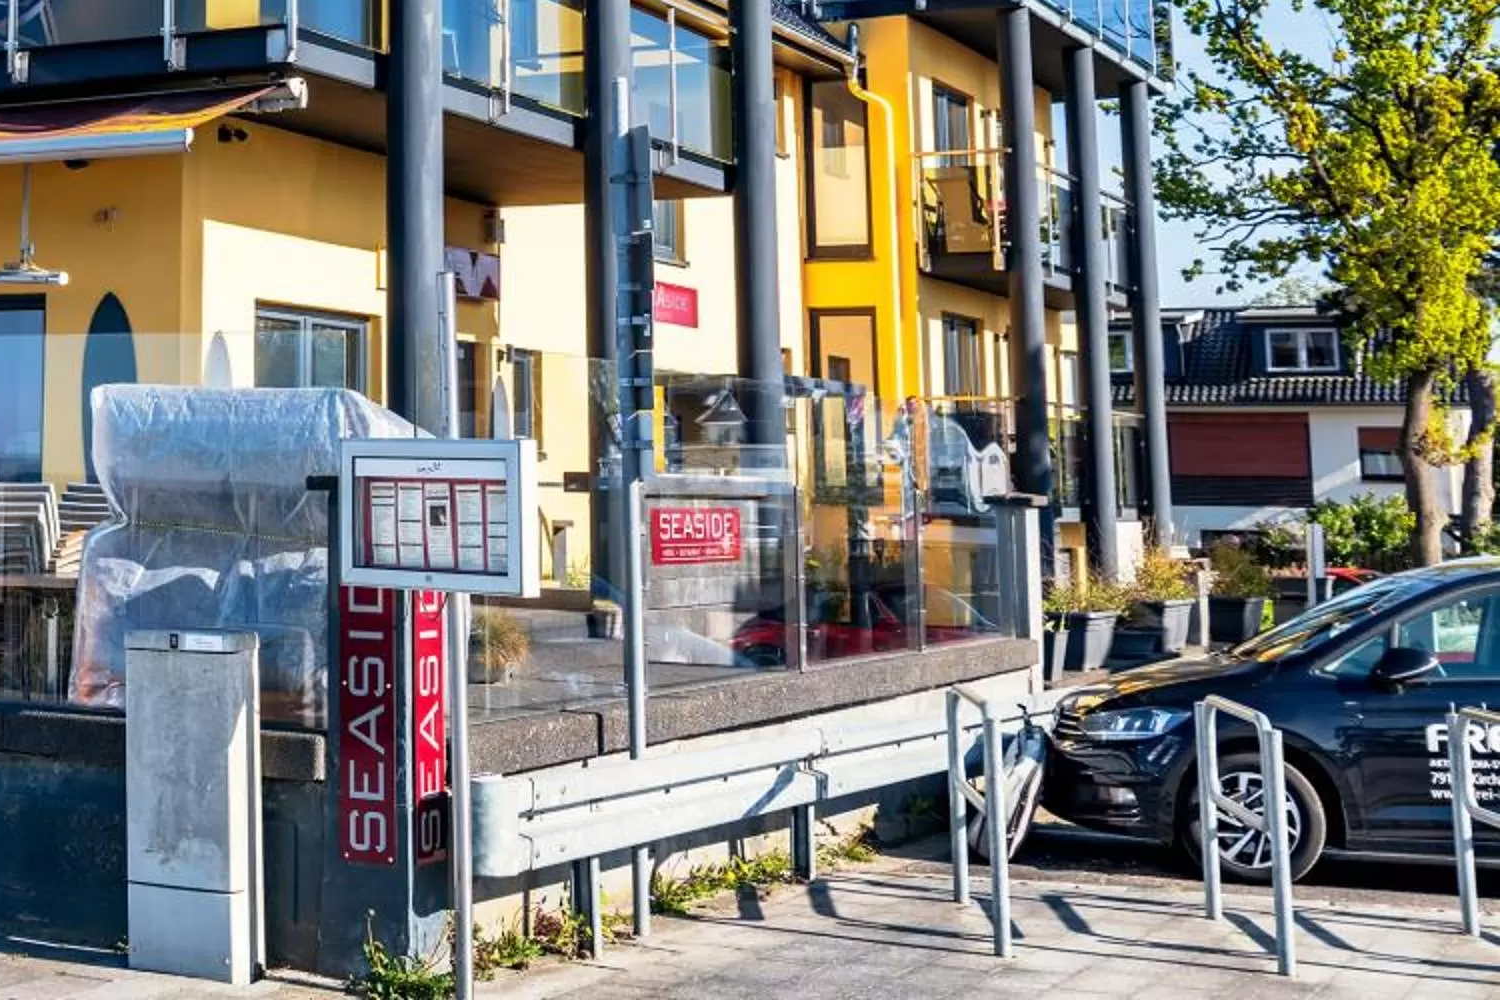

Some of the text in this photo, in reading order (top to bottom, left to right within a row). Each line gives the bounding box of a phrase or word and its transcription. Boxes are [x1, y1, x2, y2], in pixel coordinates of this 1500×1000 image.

[660, 513, 734, 540] SEASIDE
[348, 586, 386, 853] SEASID
[419, 589, 442, 852] SEASID
